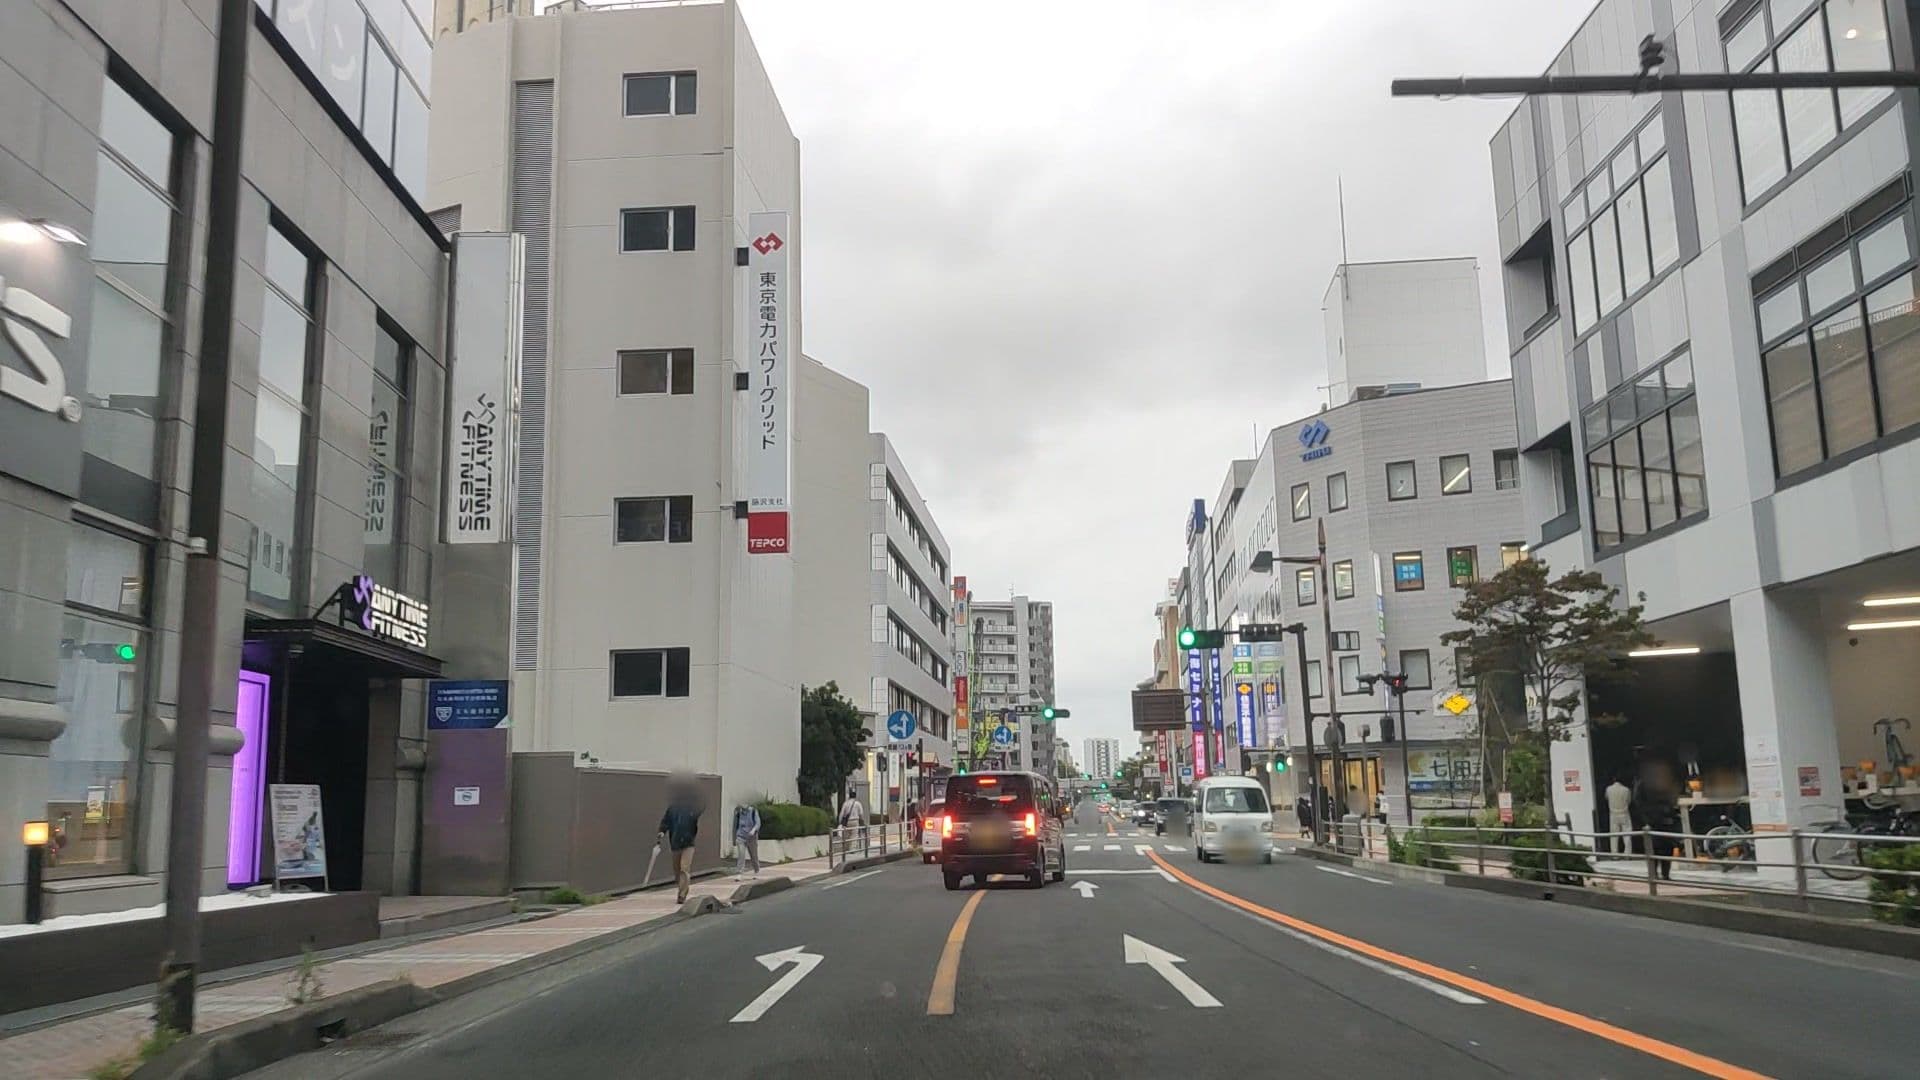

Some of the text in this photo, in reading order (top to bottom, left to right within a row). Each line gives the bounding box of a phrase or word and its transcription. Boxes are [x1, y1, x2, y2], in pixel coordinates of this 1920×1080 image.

[759, 272, 777, 450] 東京電力パワーグリッド
[458, 424, 475, 531] FITNESS
[473, 423, 493, 531] ANYTIME
[750, 538, 785, 548] TEPCO
[370, 611, 428, 648] FITNESS
[371, 584, 429, 628] ANYTIME
